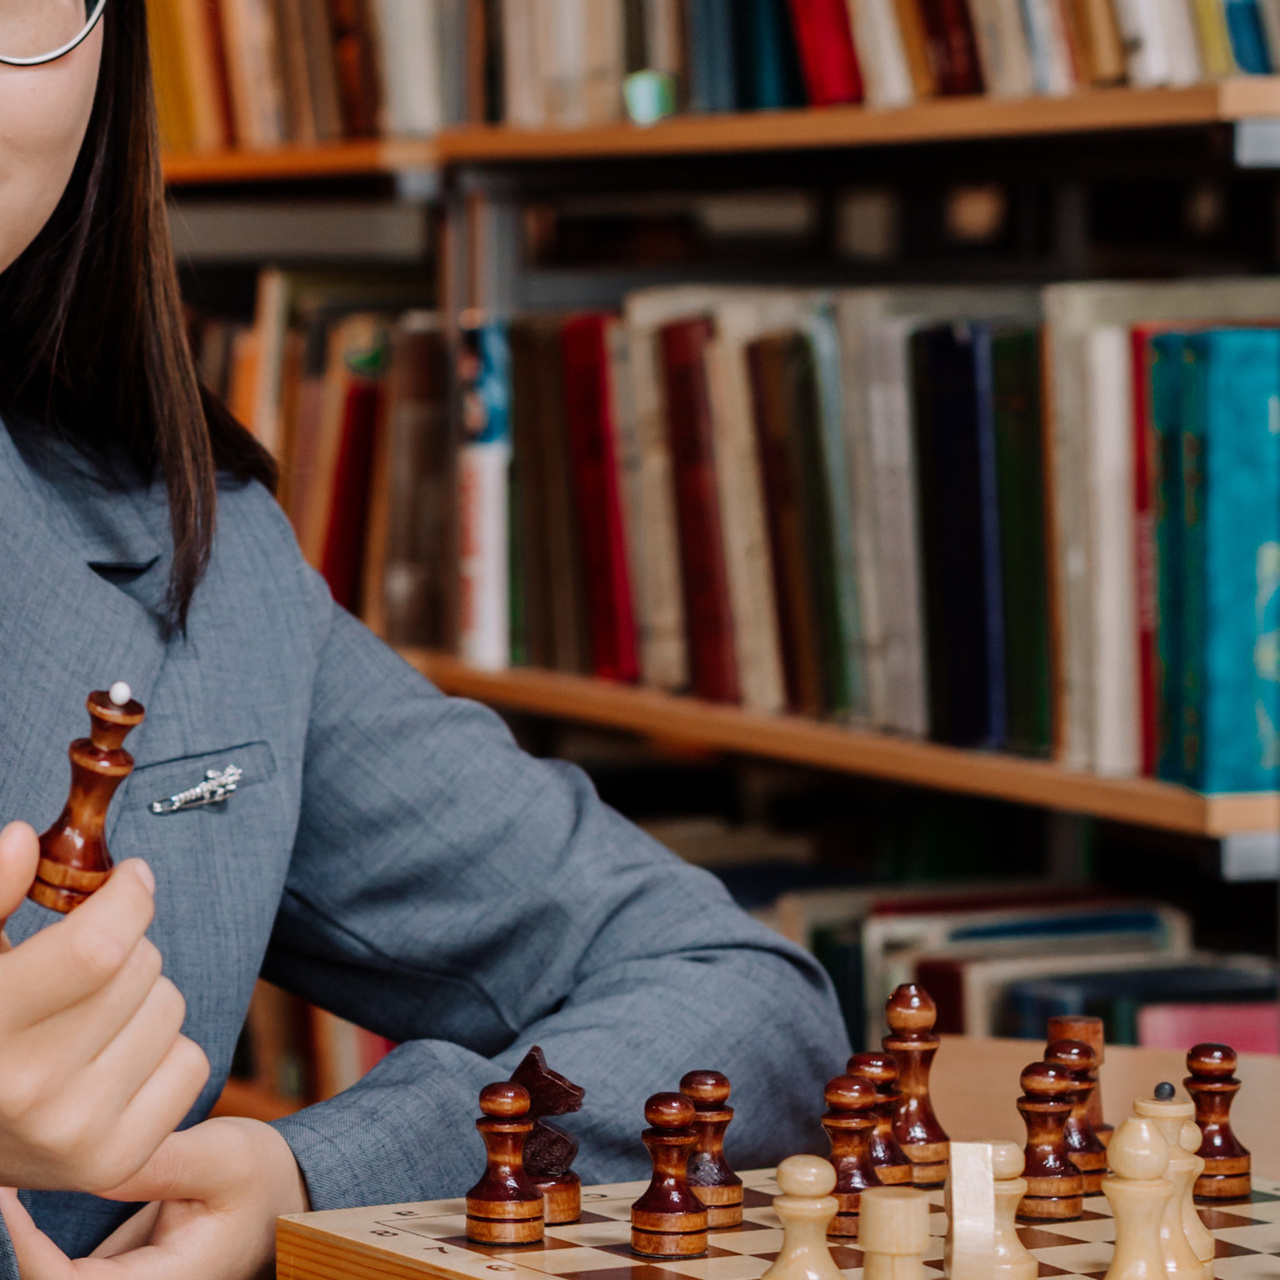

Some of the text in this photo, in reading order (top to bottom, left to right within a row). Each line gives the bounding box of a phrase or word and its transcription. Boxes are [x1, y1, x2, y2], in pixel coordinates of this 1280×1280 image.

[369, 1229, 400, 1238] 8
[422, 1246, 449, 1254] 7
[485, 1264, 516, 1272] 6
